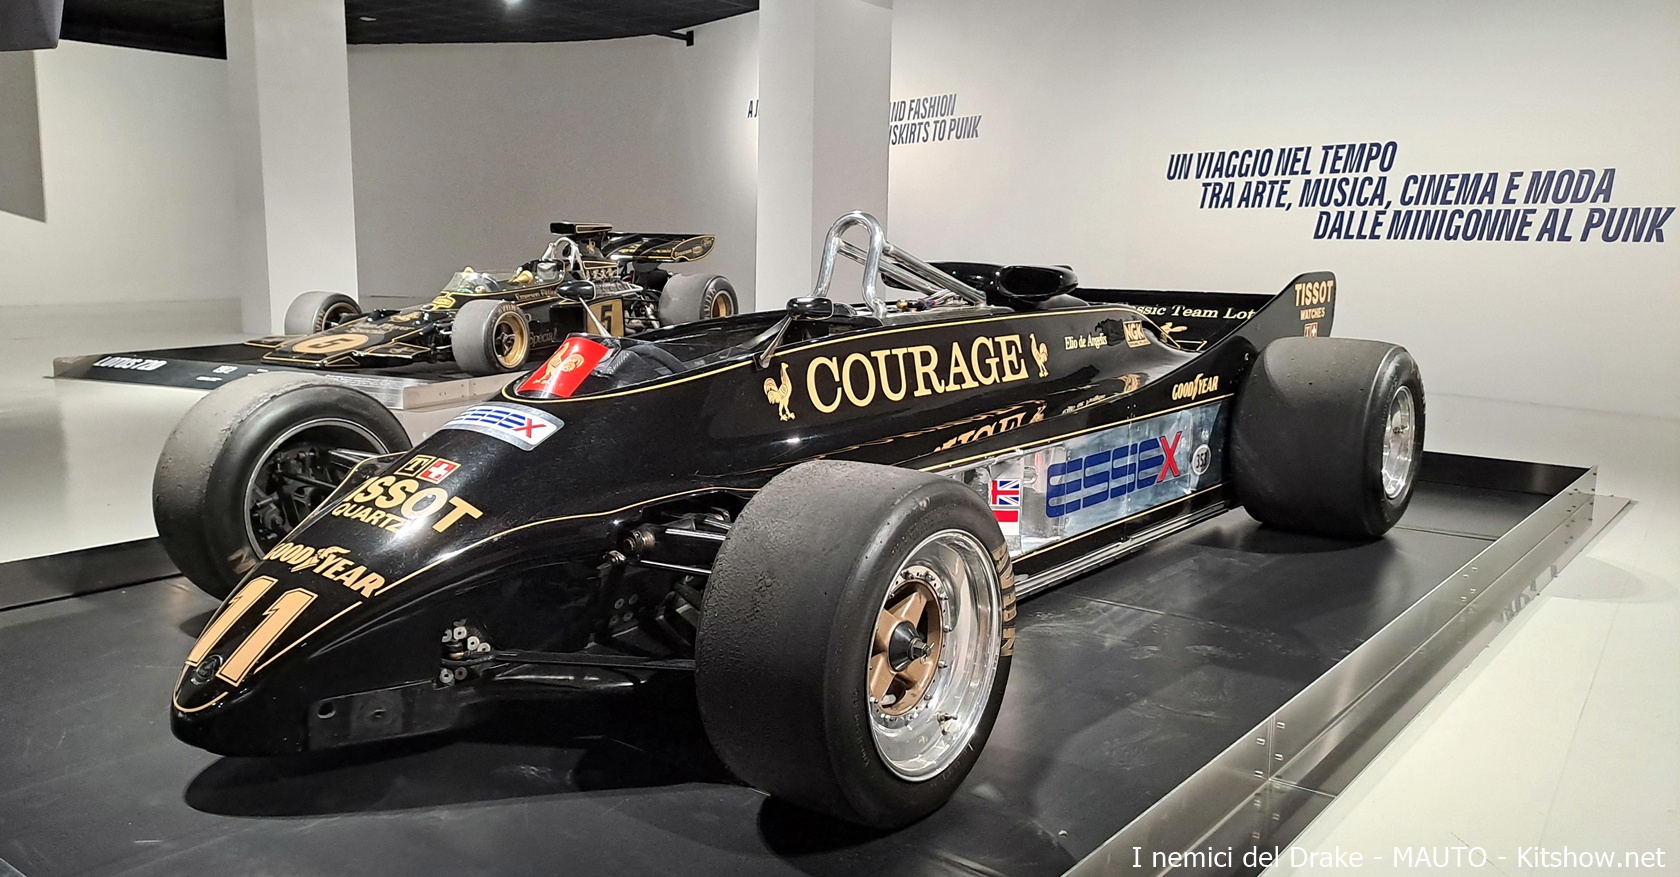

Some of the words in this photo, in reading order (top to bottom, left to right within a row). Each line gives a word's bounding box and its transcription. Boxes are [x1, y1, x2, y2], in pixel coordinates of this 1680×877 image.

[890, 100, 906, 122] ND
[907, 93, 957, 121] FASHION
[932, 118, 947, 142] TO
[947, 115, 982, 141] PUNK
[1166, 153, 1193, 180] UN
[1195, 148, 1274, 179] VIAGGIO
[1274, 146, 1312, 177] NEL
[1319, 141, 1398, 174] TEMPO
[1199, 181, 1235, 209] TRA
[1237, 179, 1292, 211] ARTE,
[1298, 176, 1392, 210] MUSICA,
[1399, 172, 1499, 206] CINEMA
[1502, 171, 1524, 204] E
[1523, 168, 1616, 204] MODA
[1313, 210, 1387, 240] DALLE
[1386, 208, 1537, 241] MINIGONNE
[1535, 208, 1574, 242] AL
[1580, 207, 1677, 242] PUNK
[1295, 280, 1334, 306] TISSOT
[601, 303, 613, 335] 5
[1171, 305, 1219, 318] Team
[1300, 307, 1325, 320] WATCHES
[1064, 336, 1078, 350] Elio
[1079, 334, 1086, 348] de
[1125, 323, 1146, 341] NGK
[806, 334, 1029, 413] COURAGE
[1046, 431, 1182, 518] ESSEX
[331, 502, 409, 534] QUARTZ
[185, 575, 318, 687] 11
